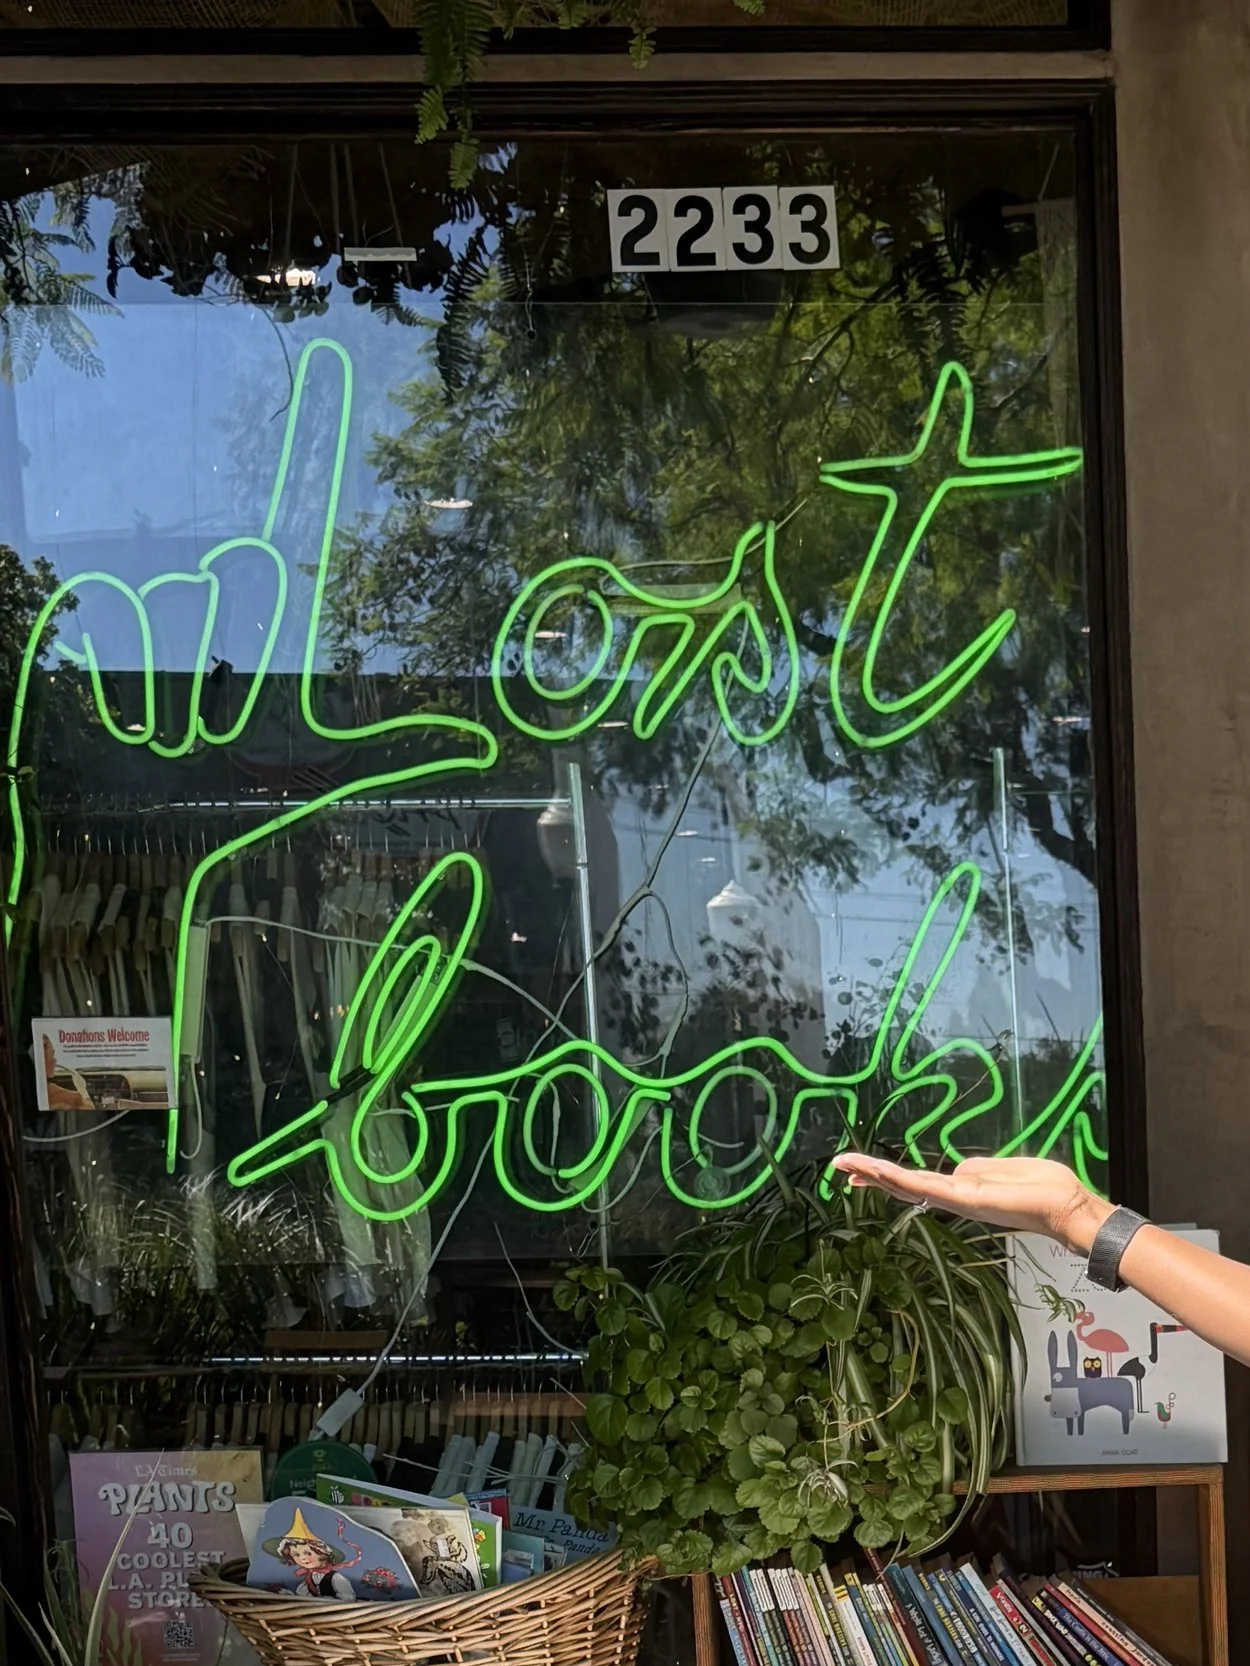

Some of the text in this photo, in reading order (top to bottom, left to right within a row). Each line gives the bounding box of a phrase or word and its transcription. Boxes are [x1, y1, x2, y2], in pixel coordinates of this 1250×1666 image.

[617, 193, 831, 266] 2233
[107, 1027, 150, 1042] Welcome
[99, 1480, 236, 1516] PLANTS
[147, 1521, 194, 1549] 40
[117, 1551, 227, 1571] COOLEST
[108, 1573, 152, 1591] L.A.
